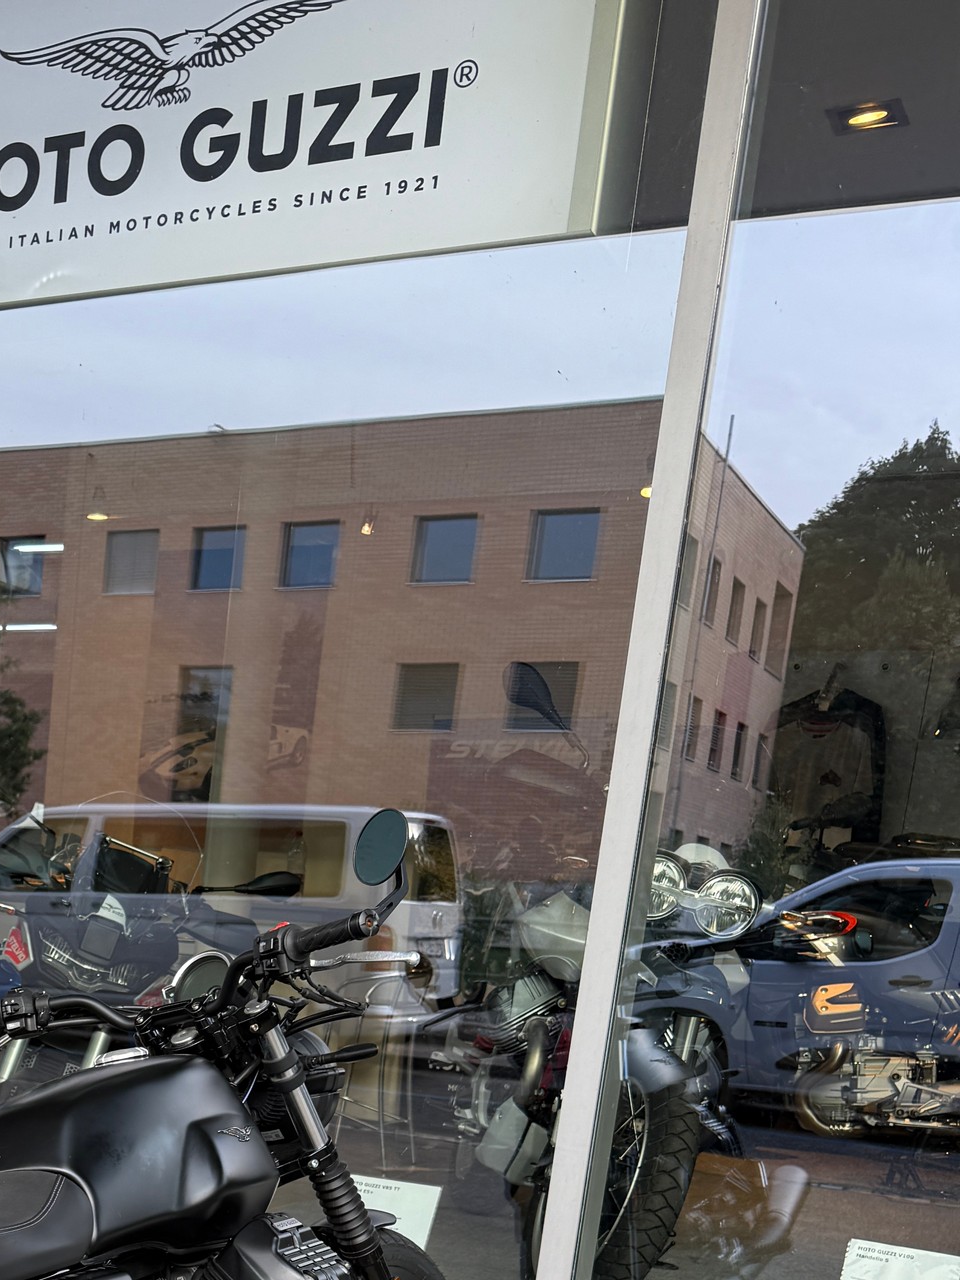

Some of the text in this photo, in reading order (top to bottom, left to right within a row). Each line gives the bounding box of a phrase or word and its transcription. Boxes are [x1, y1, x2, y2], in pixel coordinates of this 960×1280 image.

[9, 224, 95, 248] ITALIAN
[109, 198, 277, 234] MOTORCYCLES
[293, 185, 367, 207] SINCE
[384, 175, 439, 195] 1921
